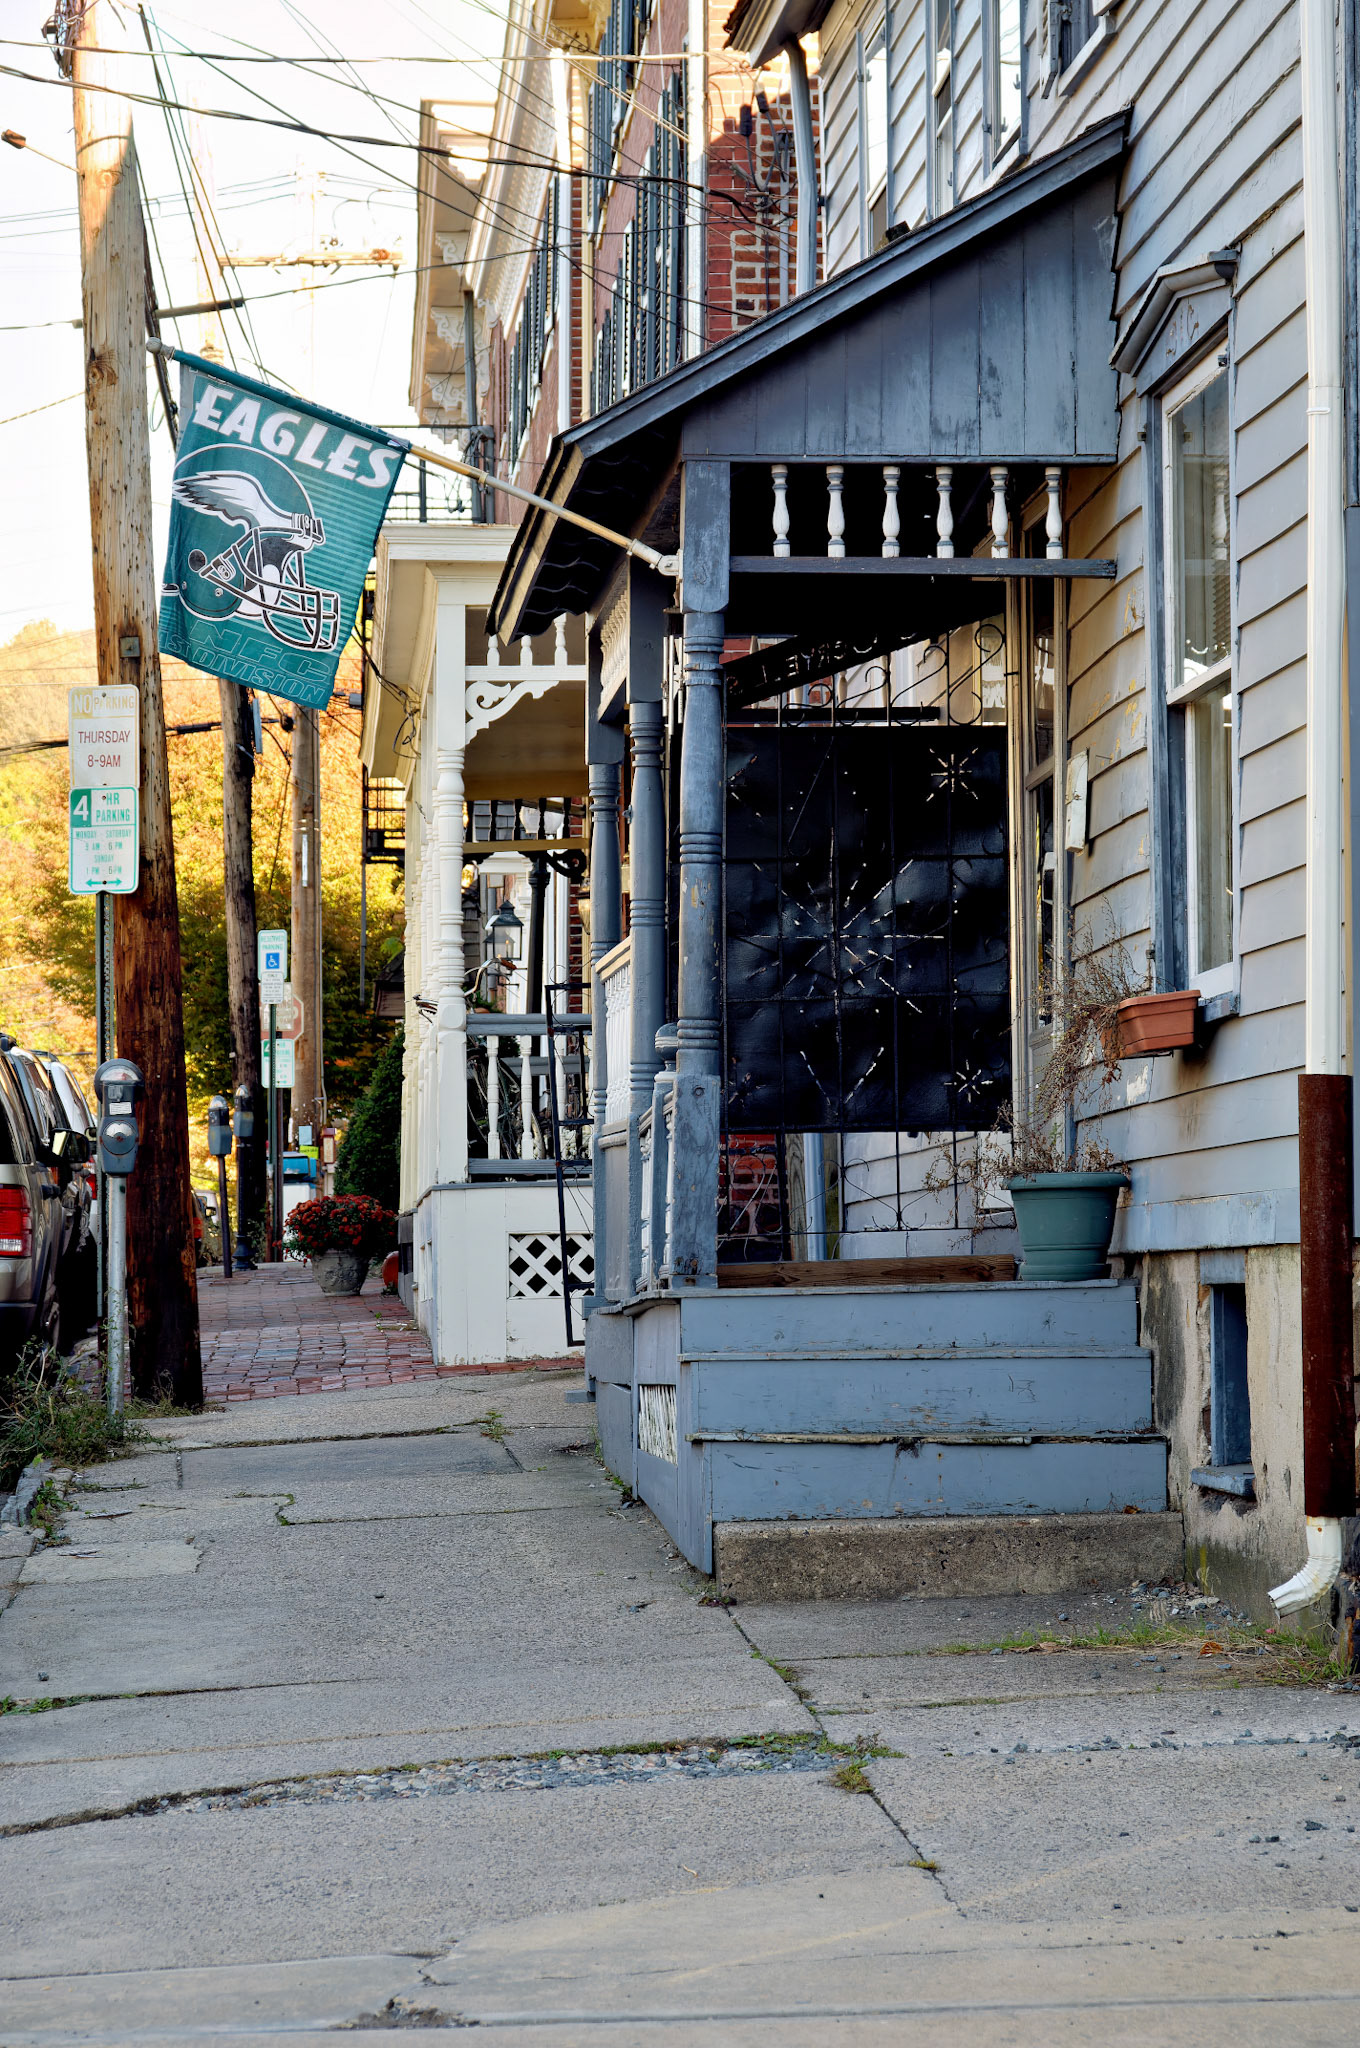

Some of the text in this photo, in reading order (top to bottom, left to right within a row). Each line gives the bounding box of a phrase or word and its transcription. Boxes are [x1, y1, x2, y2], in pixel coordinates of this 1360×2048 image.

[192, 384, 402, 489] EAGLES
[188, 620, 332, 683] NFC
[192, 647, 326, 704] DIVISION
[74, 694, 135, 713] NO PARKING
[78, 730, 131, 744] THURSDAY
[87, 754, 121, 768] 8-9AM
[73, 792, 120, 821] 4 HR
[96, 808, 130, 823] PARKING
[75, 829, 132, 839] MONDAY SATURDAY
[94, 854, 114, 863] SUNDAY
